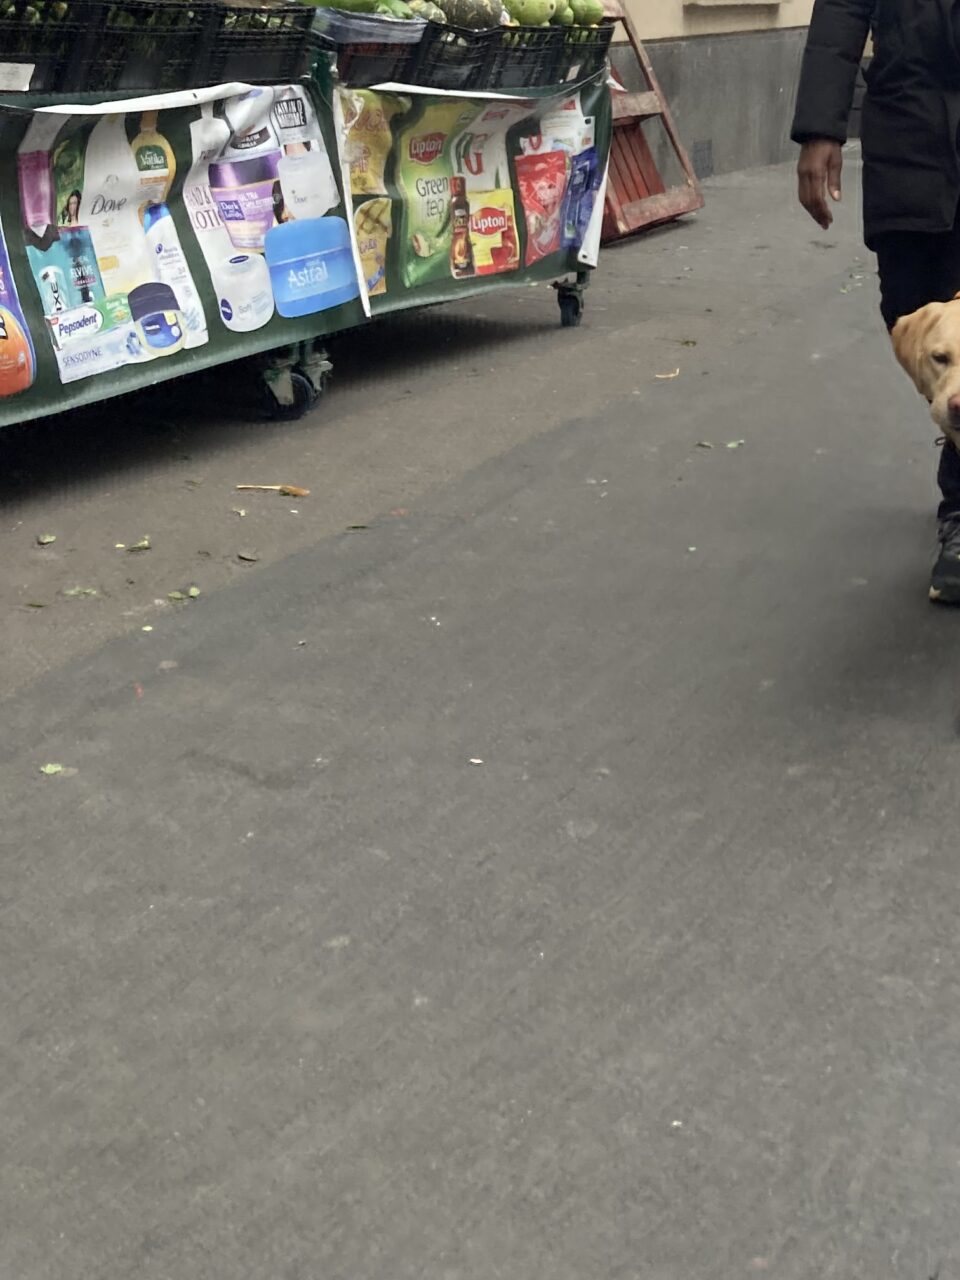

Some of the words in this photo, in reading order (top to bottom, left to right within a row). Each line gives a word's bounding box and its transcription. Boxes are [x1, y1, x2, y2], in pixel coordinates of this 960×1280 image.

[411, 138, 442, 158] Lipton
[139, 152, 165, 168] Vatika
[416, 176, 449, 197] Green
[90, 194, 127, 216] Dove
[426, 198, 444, 218] tea
[471, 213, 505, 232] Lipton
[287, 261, 329, 288] Astral
[58, 313, 98, 337] Pepsodent
[62, 347, 103, 367] SENSODYNE
